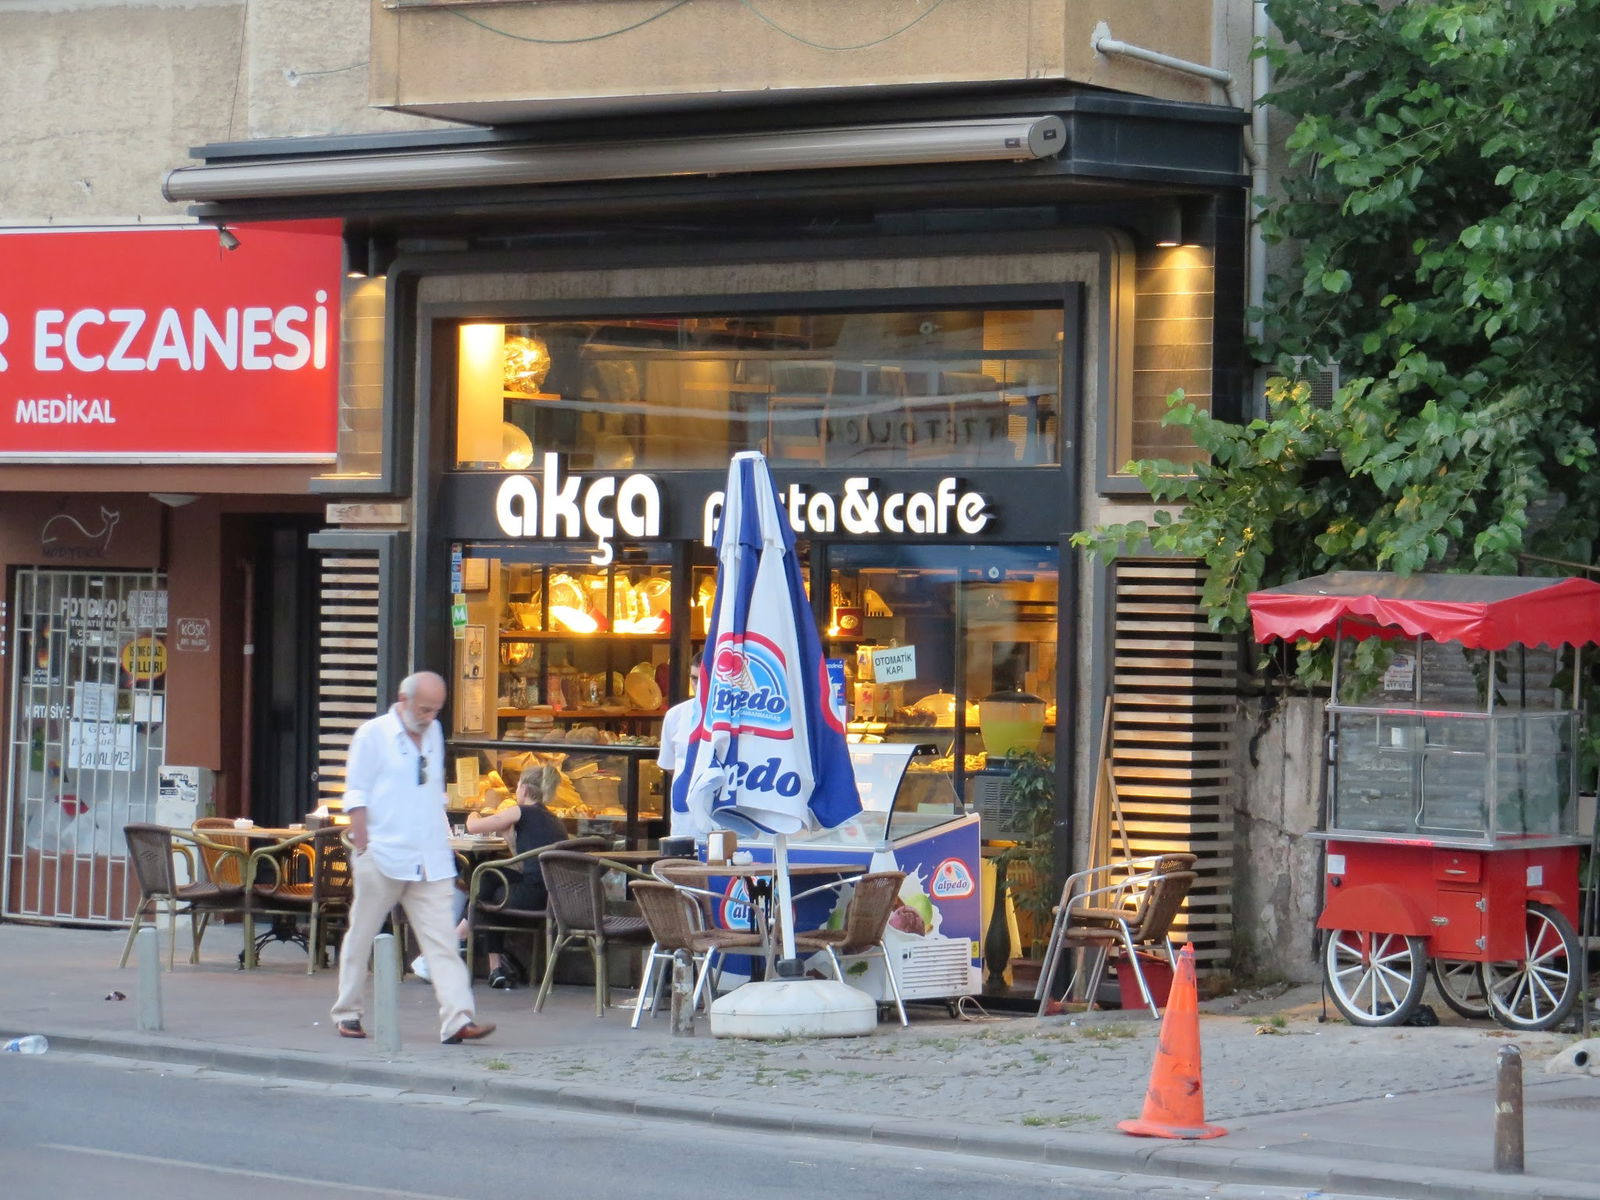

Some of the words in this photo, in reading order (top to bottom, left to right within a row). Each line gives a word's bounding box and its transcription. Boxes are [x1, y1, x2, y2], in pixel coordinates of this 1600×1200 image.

[34, 289, 328, 372] ECZANESİ
[15, 394, 116, 424] MEDİKAL
[496, 452, 660, 566] akça
[703, 477, 987, 546] pta&cafe
[61, 598, 128, 618] FOTOKOP
[874, 652, 912, 666] OTOMATİK
[886, 665, 904, 675] KAPI
[25, 703, 71, 719] KRTASİYE
[937, 880, 968, 891] alpedo
